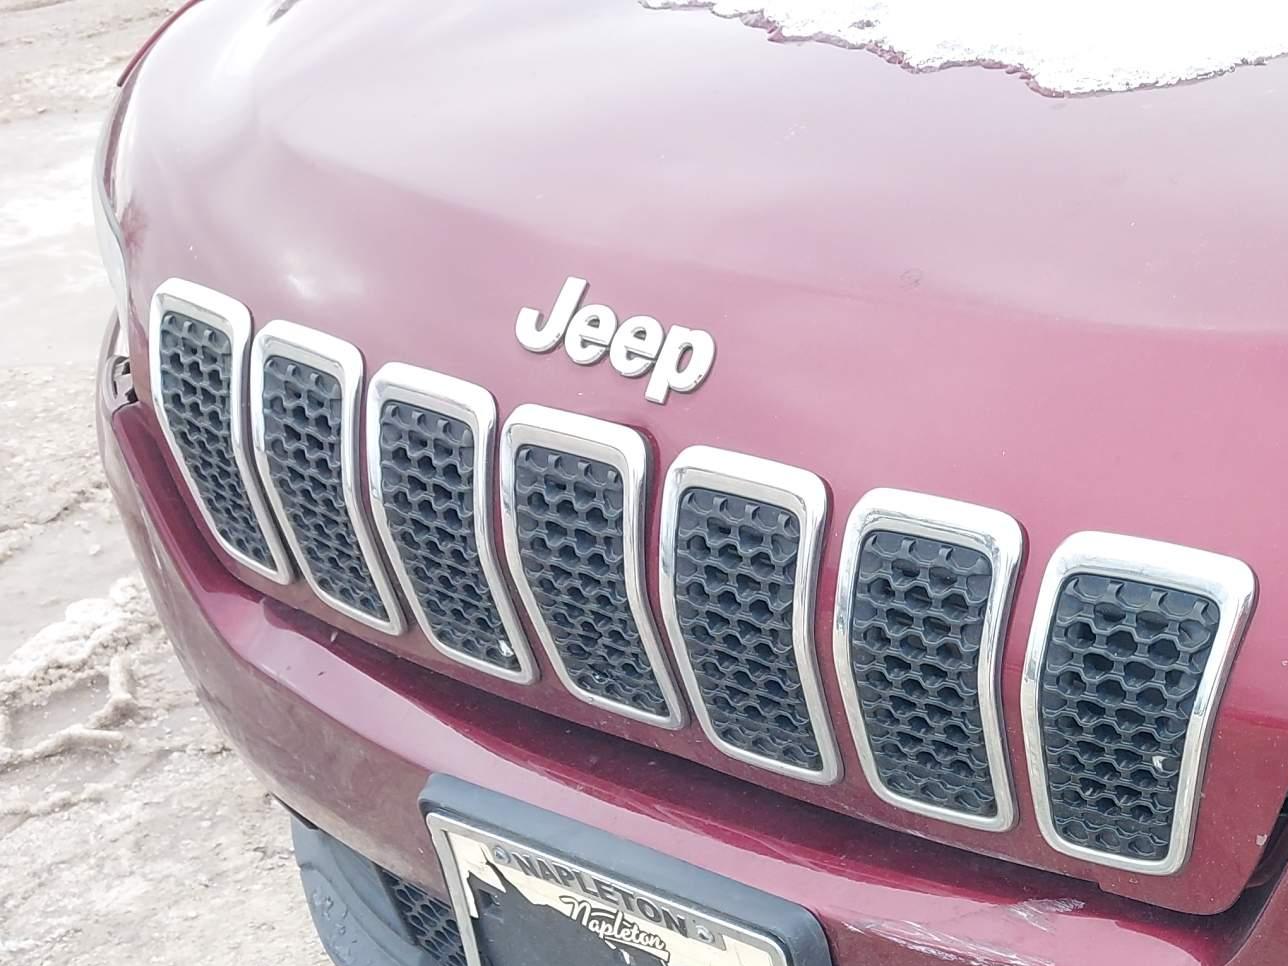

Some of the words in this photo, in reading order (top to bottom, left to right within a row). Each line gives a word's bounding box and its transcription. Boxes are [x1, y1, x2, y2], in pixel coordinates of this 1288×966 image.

[515, 276, 717, 405] Jeep
[511, 852, 689, 938] NAPLETON
[558, 895, 668, 952] Napleton
